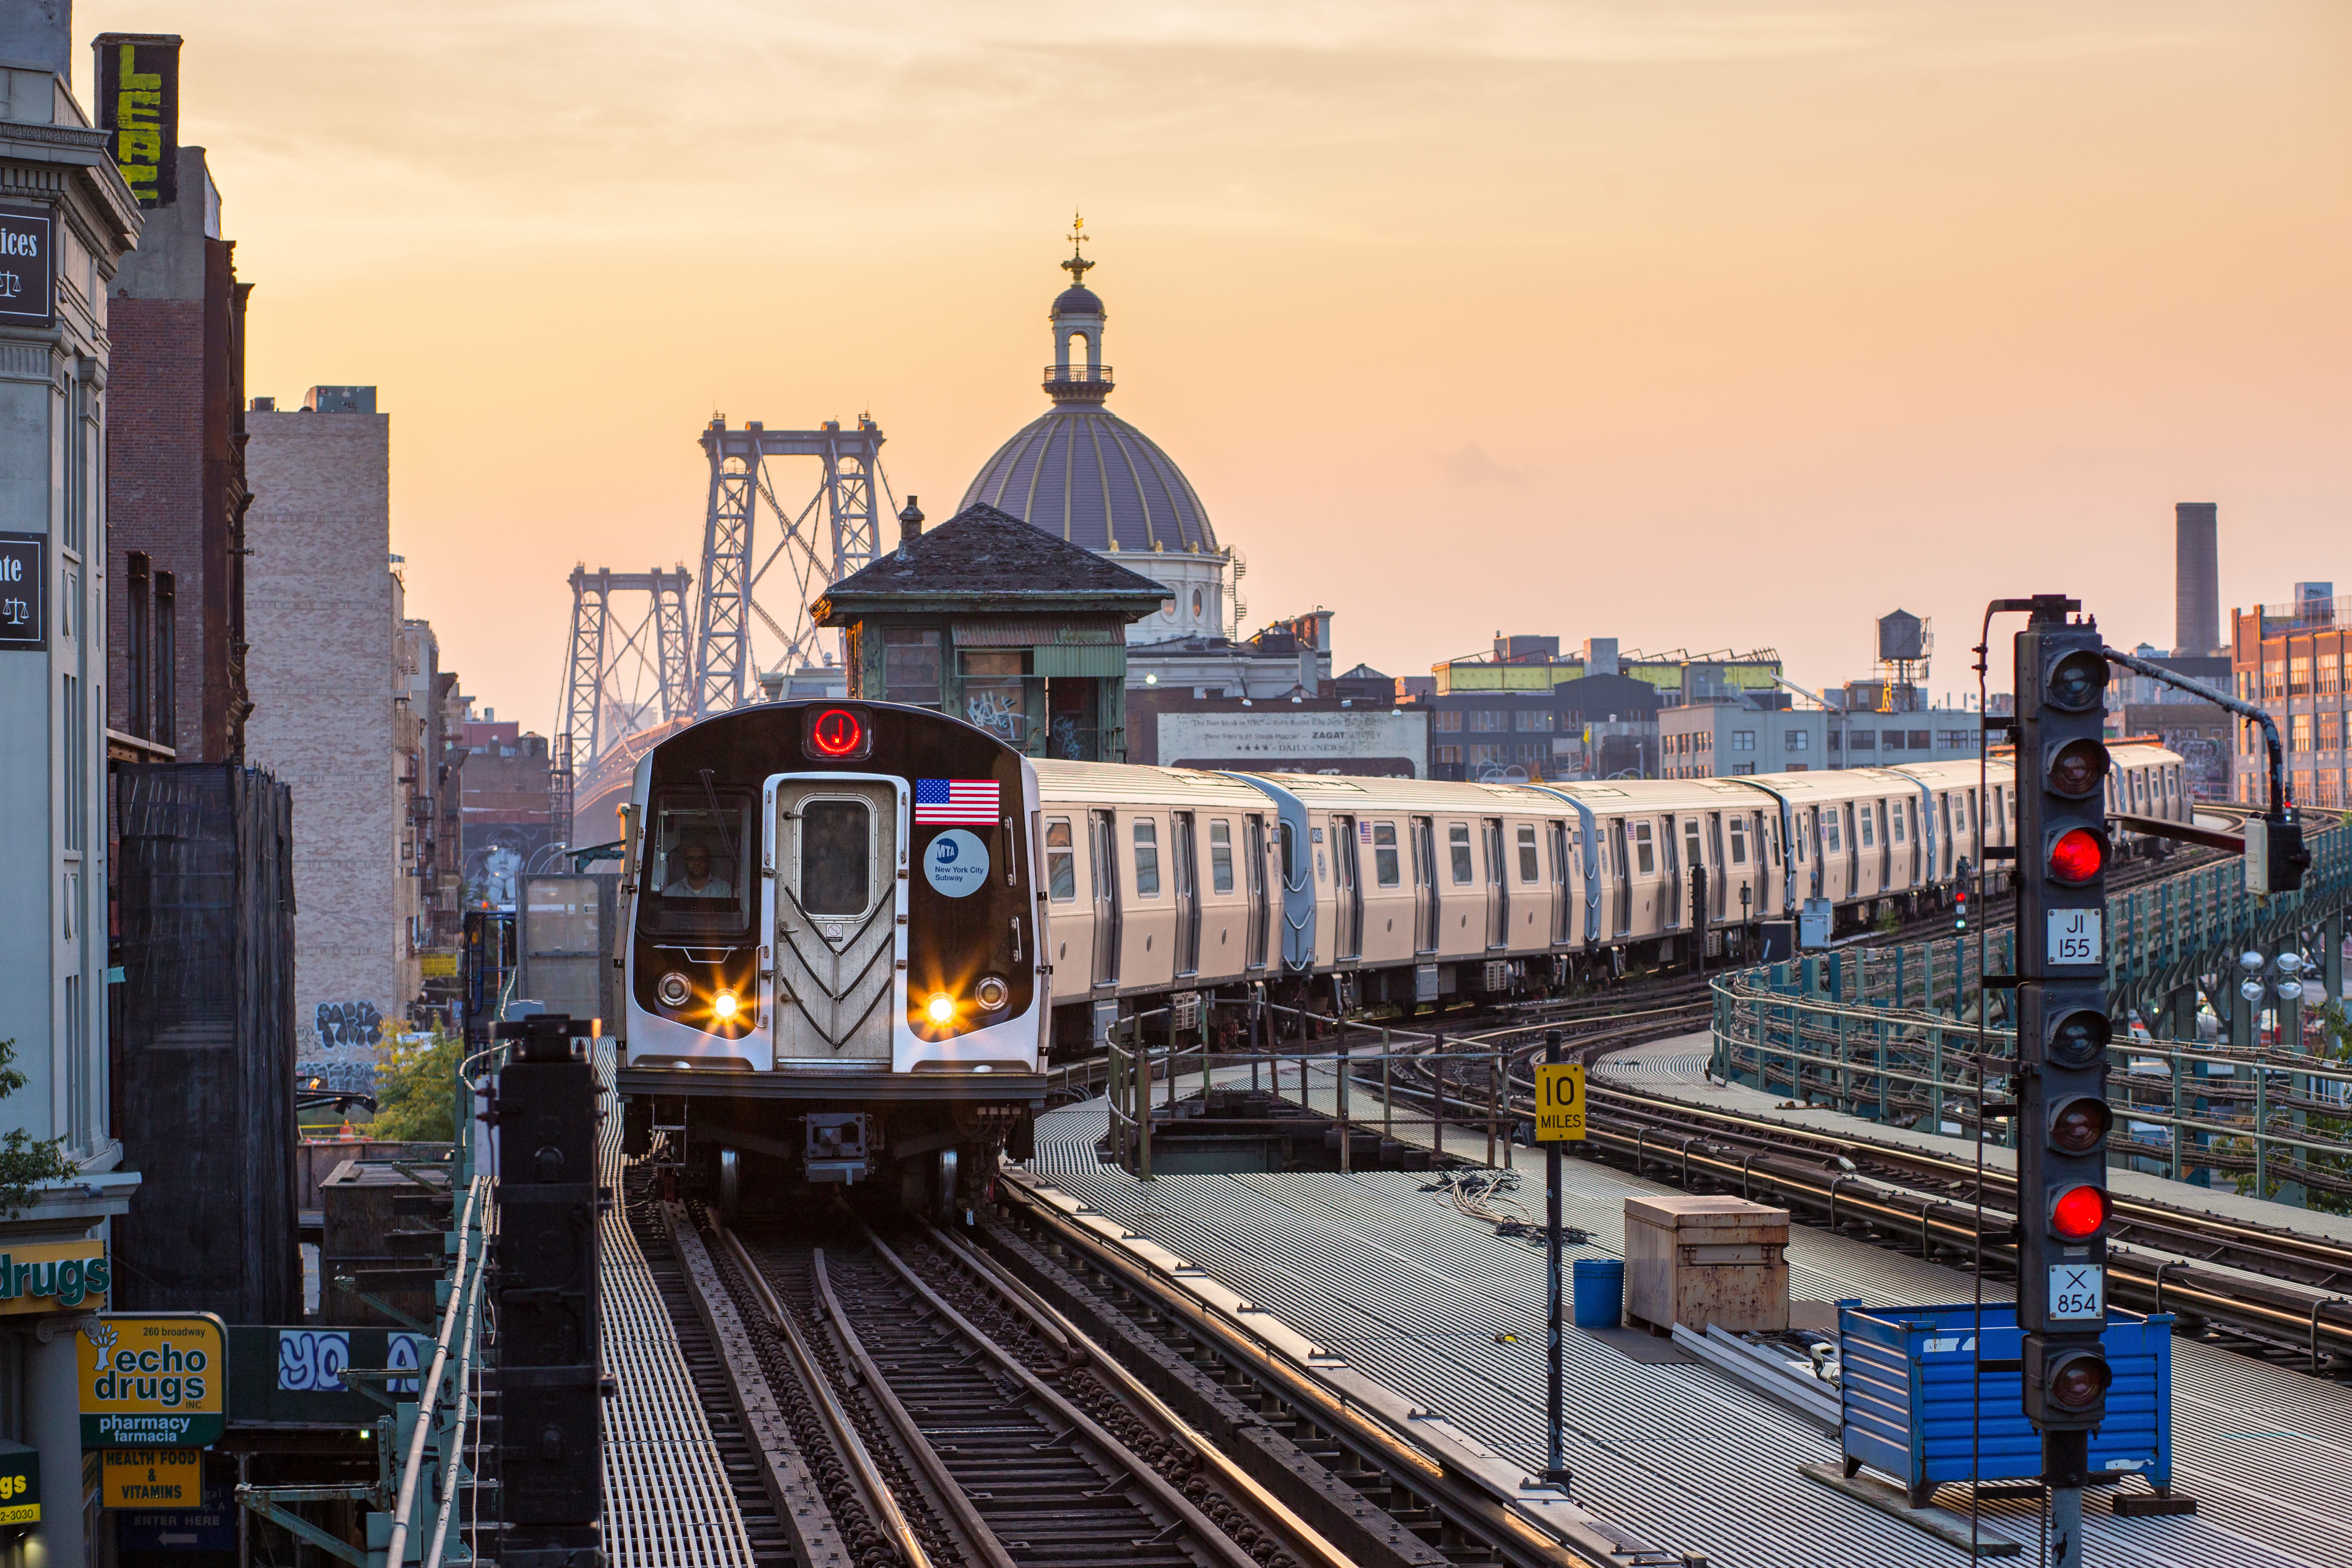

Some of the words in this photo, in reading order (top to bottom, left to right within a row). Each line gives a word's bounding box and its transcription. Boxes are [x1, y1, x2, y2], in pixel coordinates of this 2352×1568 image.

[831, 719, 843, 745] J
[936, 844, 955, 858] MTA
[2060, 939, 2090, 957] 155
[1546, 1077, 1574, 1106] 10
[1541, 1114, 1581, 1129] MILES
[2066, 1270, 2087, 1289] X
[2058, 1293, 2096, 1313] 854
[143, 1327, 159, 1336] 260
[162, 1327, 205, 1338] broadway
[115, 1342, 208, 1373] echo
[94, 1369, 206, 1407] drugs
[185, 1401, 205, 1409] INC.
[100, 1414, 190, 1433] pharmacy
[114, 1430, 177, 1442] farmacia
[106, 1451, 155, 1465] HEALTH
[160, 1451, 196, 1465] FOOD
[148, 1468, 156, 1482] &
[121, 1485, 182, 1499] VITAMINS
[134, 1515, 177, 1526] ENTER
[185, 1515, 220, 1526] HERE
